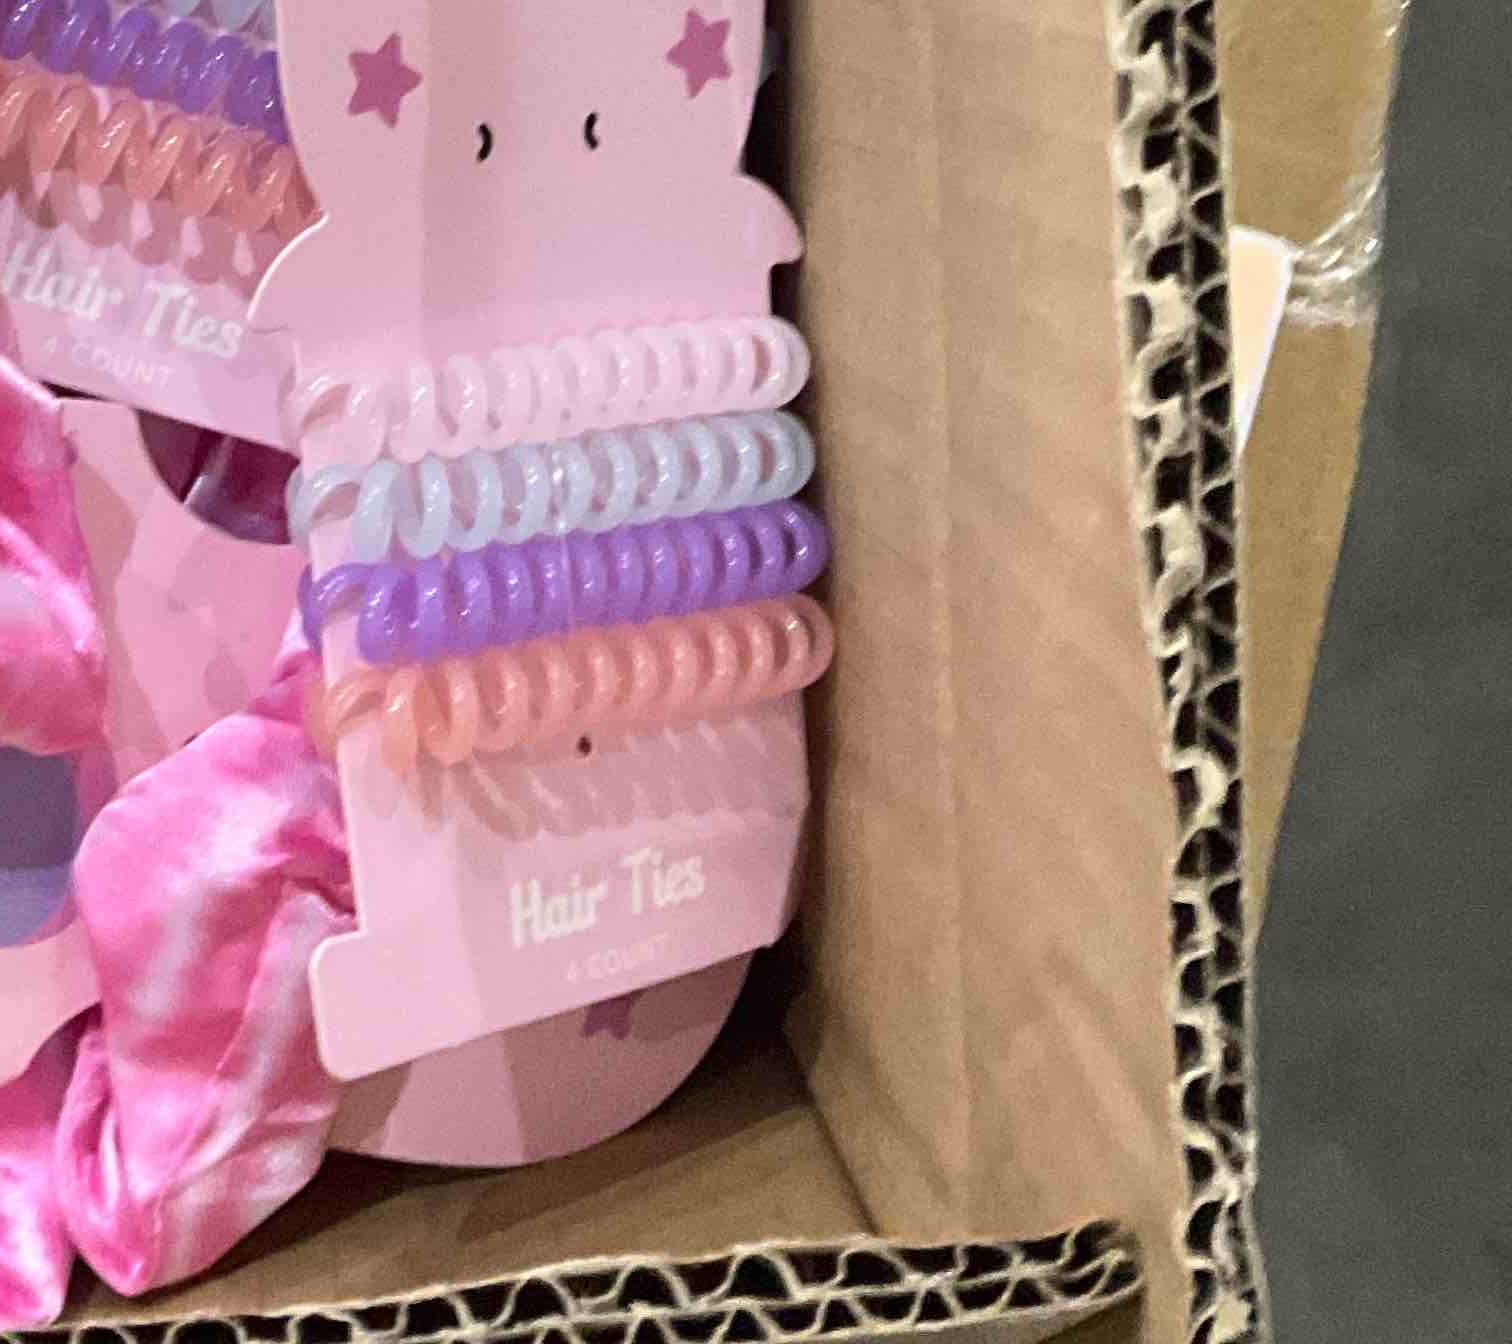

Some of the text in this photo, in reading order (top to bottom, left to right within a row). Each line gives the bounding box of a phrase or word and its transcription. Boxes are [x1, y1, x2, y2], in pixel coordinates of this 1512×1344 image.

[0, 242, 244, 359] Hair Ties
[509, 846, 707, 950] Hair Ties
